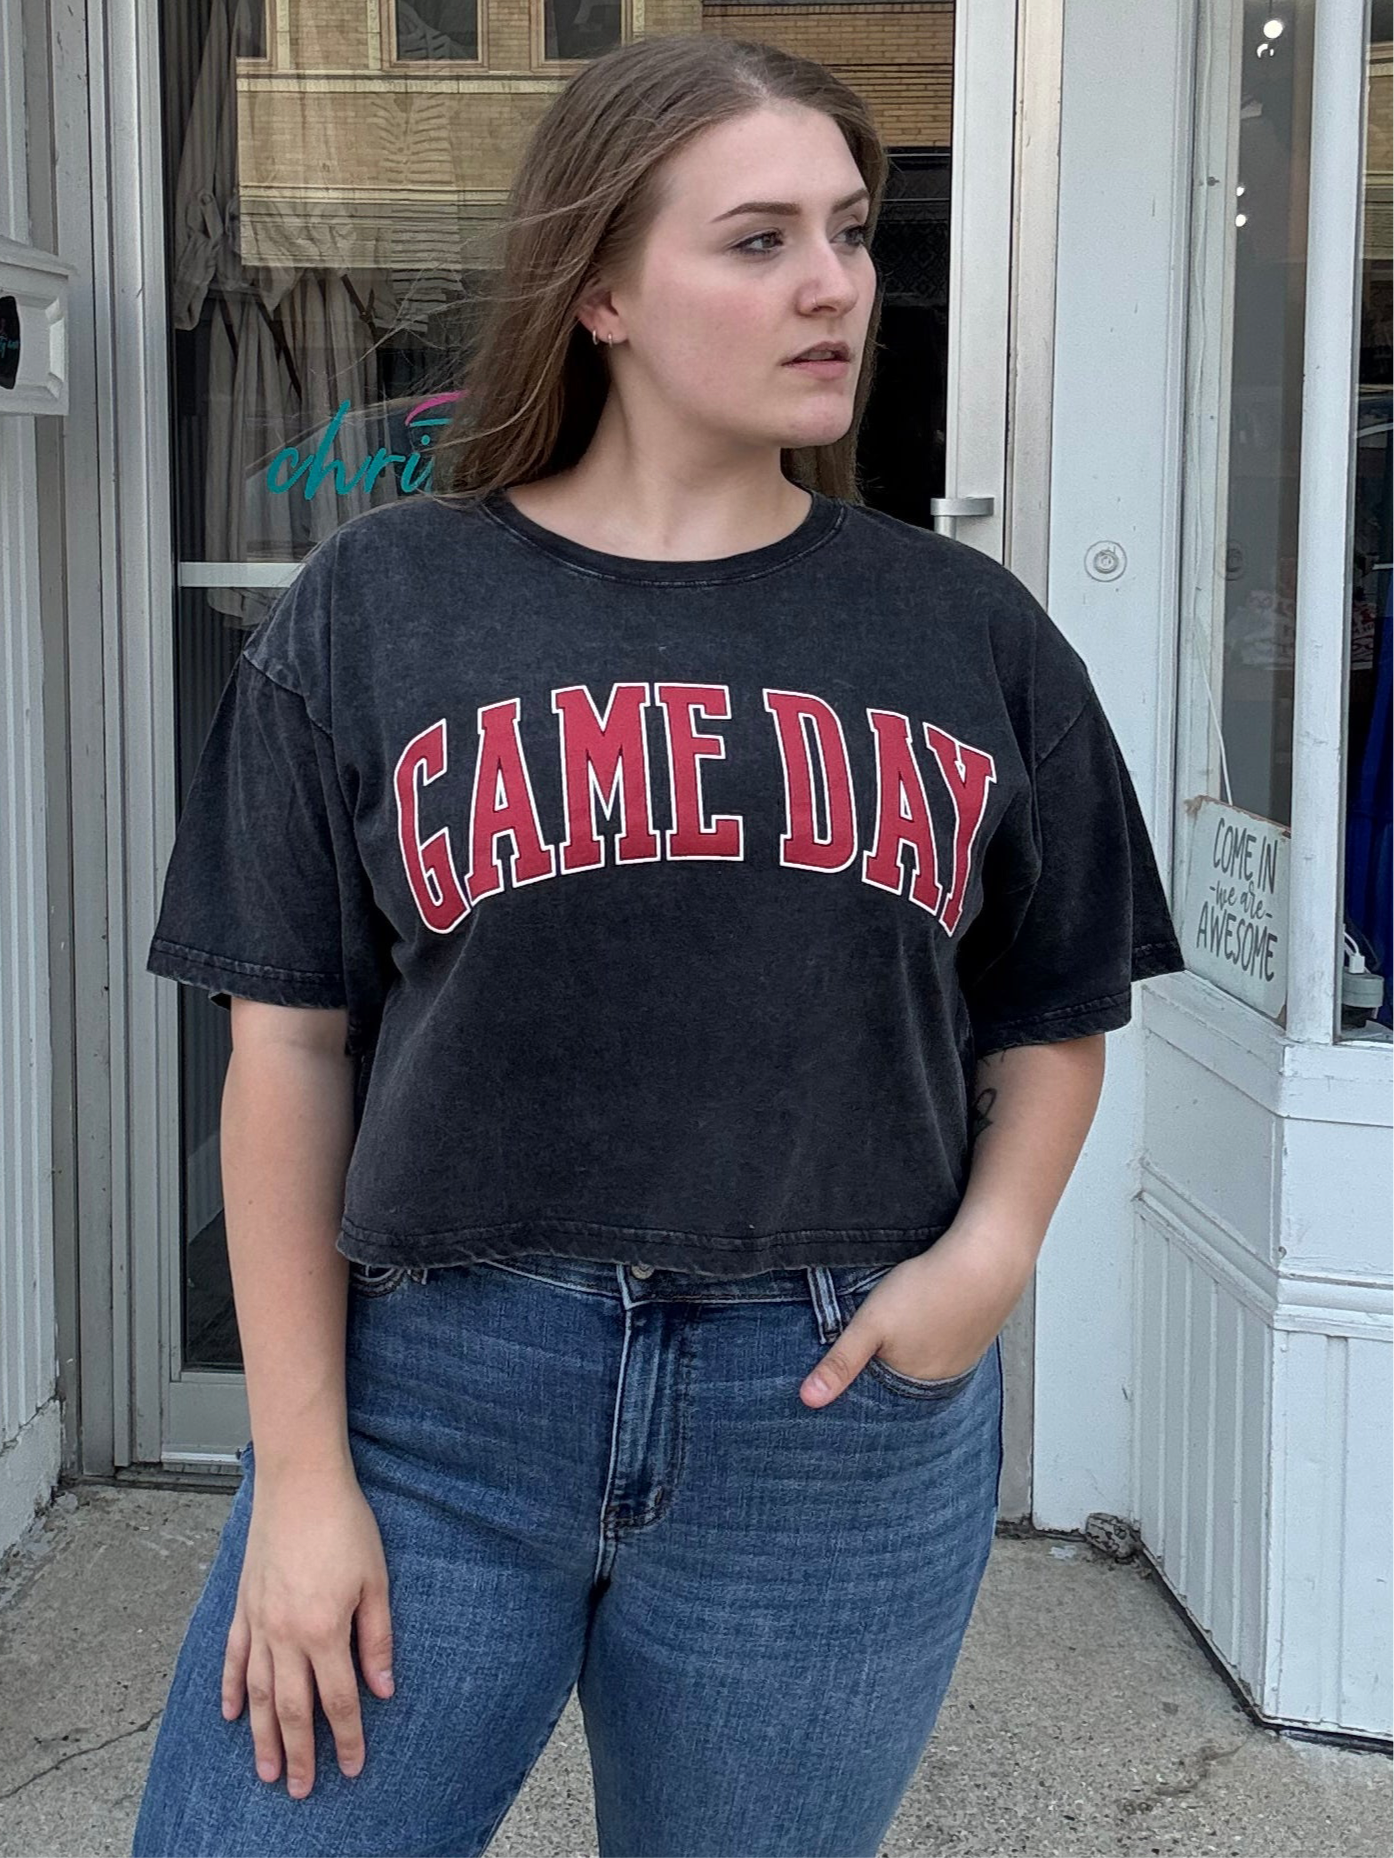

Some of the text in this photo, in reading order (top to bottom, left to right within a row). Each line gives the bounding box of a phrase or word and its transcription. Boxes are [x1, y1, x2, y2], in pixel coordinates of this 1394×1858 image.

[267, 399, 434, 500] chri
[394, 683, 996, 936] GAME DAY
[1213, 817, 1278, 894] COME IN
[1196, 901, 1278, 982] AWESOME
